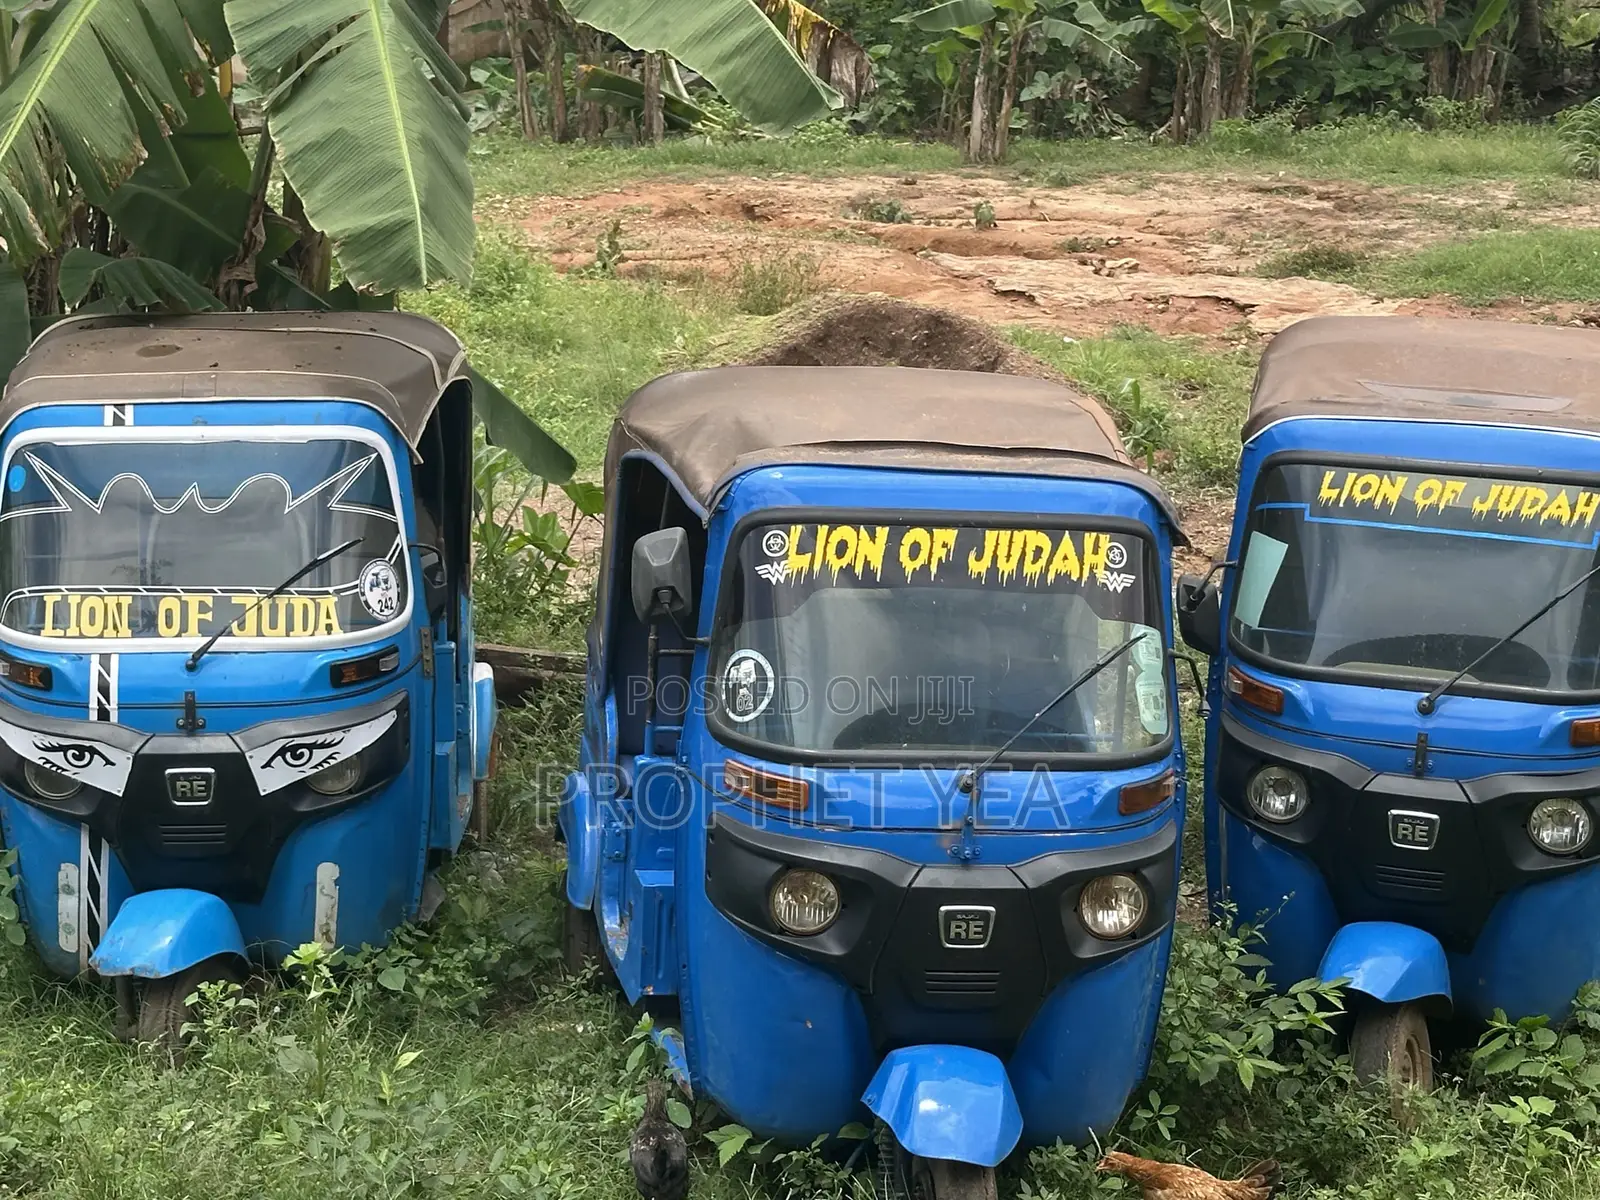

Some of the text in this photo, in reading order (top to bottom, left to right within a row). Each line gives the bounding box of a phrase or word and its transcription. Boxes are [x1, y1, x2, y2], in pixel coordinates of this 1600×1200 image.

[1317, 470, 1600, 529] LION OF JUDAH
[788, 525, 1110, 588] LION OF JUDAH
[377, 597, 394, 613] 242
[41, 595, 344, 637] LION OF JUDA
[736, 694, 754, 712] 02
[176, 780, 207, 797] RE
[1397, 823, 1429, 842] RE
[949, 920, 984, 940] RE
